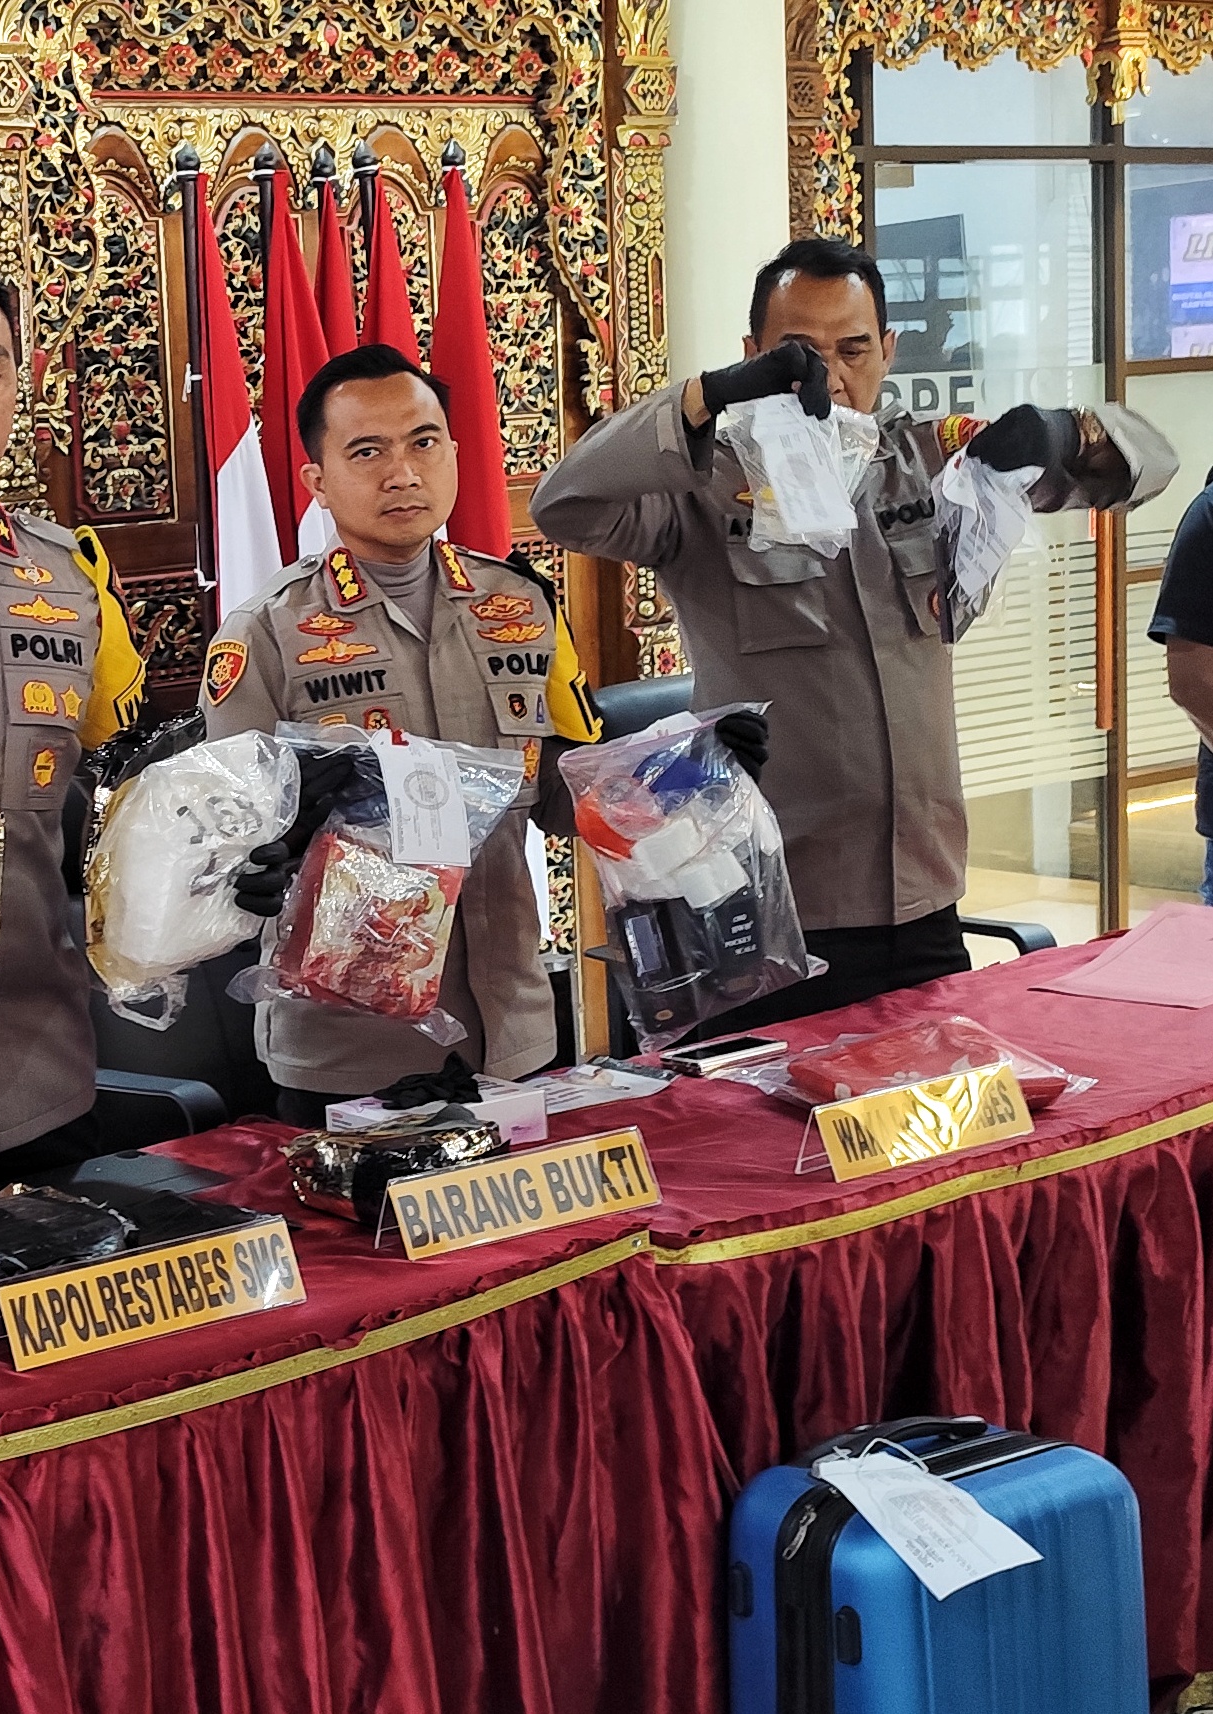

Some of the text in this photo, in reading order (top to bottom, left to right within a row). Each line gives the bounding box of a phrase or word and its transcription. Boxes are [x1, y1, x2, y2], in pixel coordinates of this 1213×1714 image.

[10, 633, 83, 667] POLRI
[304, 668, 388, 704] WIWIT
[397, 1143, 649, 1249] BARANG BUKTI
[8, 1232, 295, 1357] KAPOLRESTABES SMG
